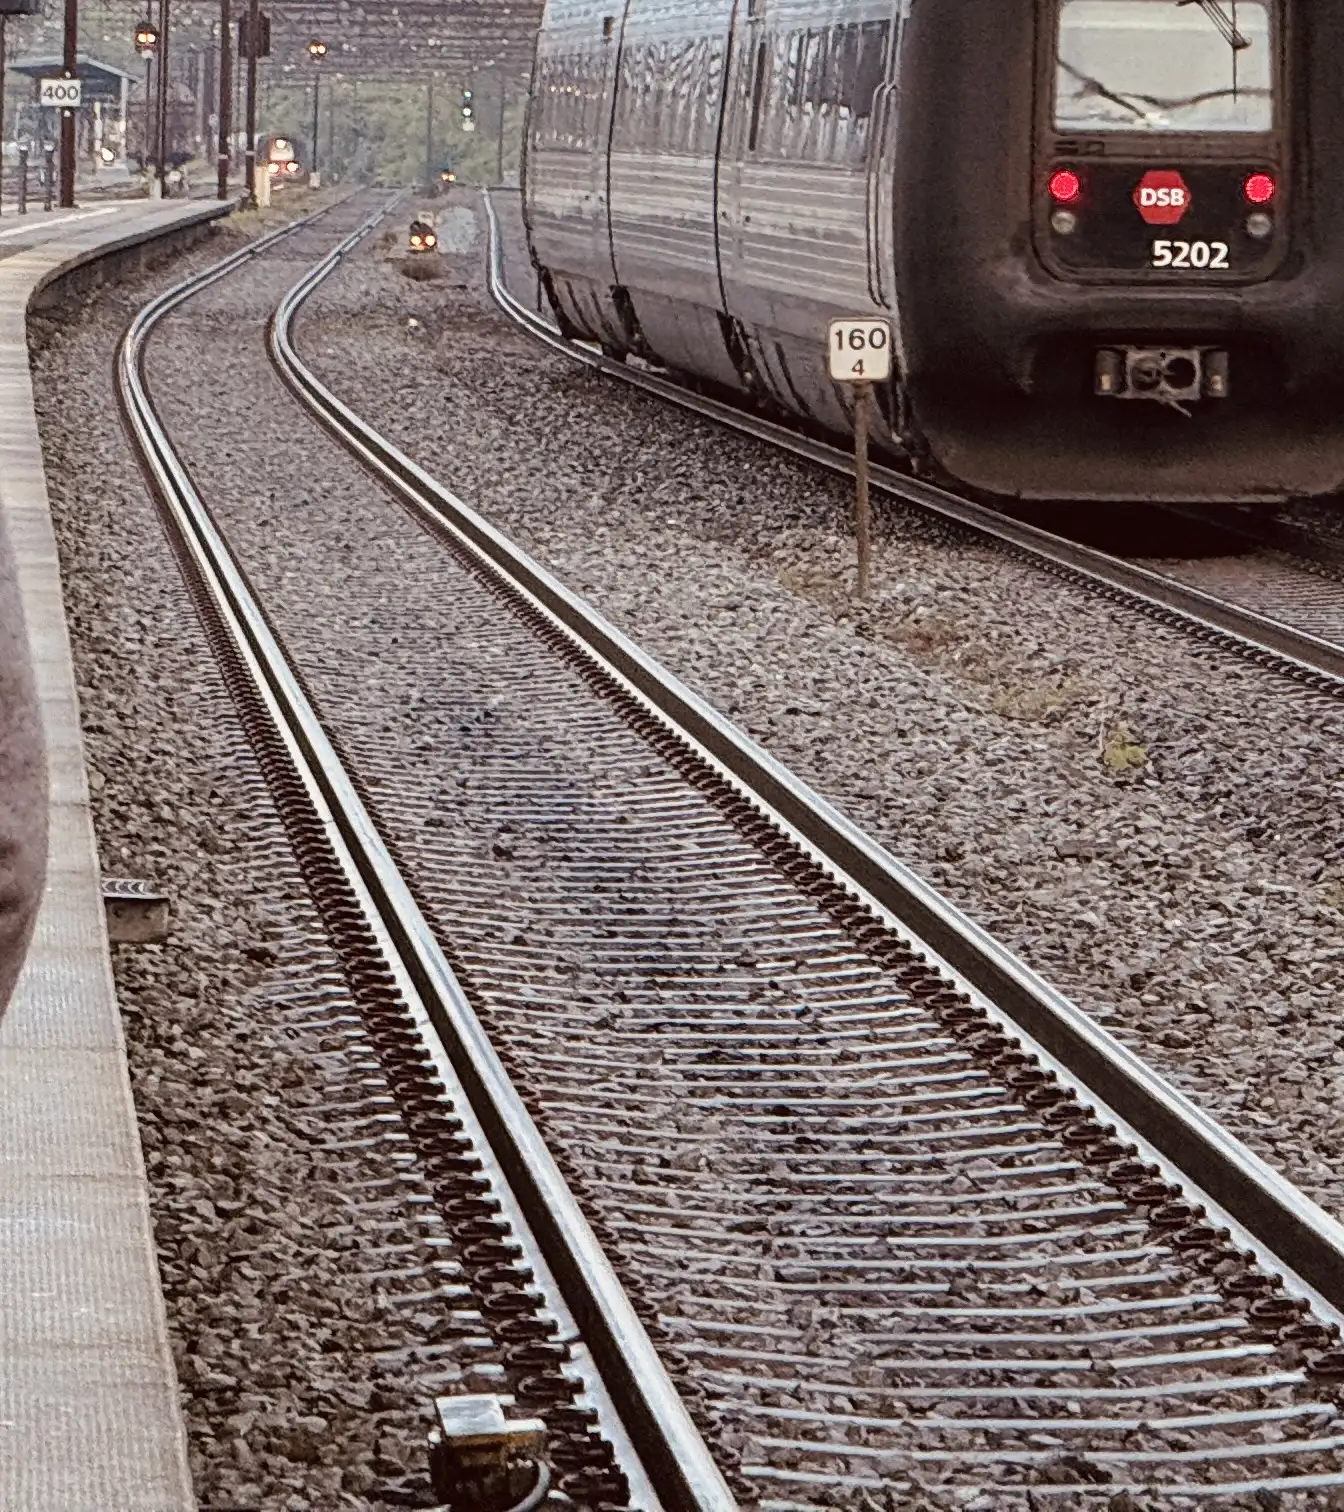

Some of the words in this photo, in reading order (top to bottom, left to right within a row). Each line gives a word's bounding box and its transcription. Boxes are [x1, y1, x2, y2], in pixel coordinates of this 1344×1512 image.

[43, 85, 79, 101] 400
[1140, 187, 1185, 207] DSB
[1152, 239, 1230, 269] 5202
[835, 327, 887, 351] 160
[851, 358, 865, 376] 4
